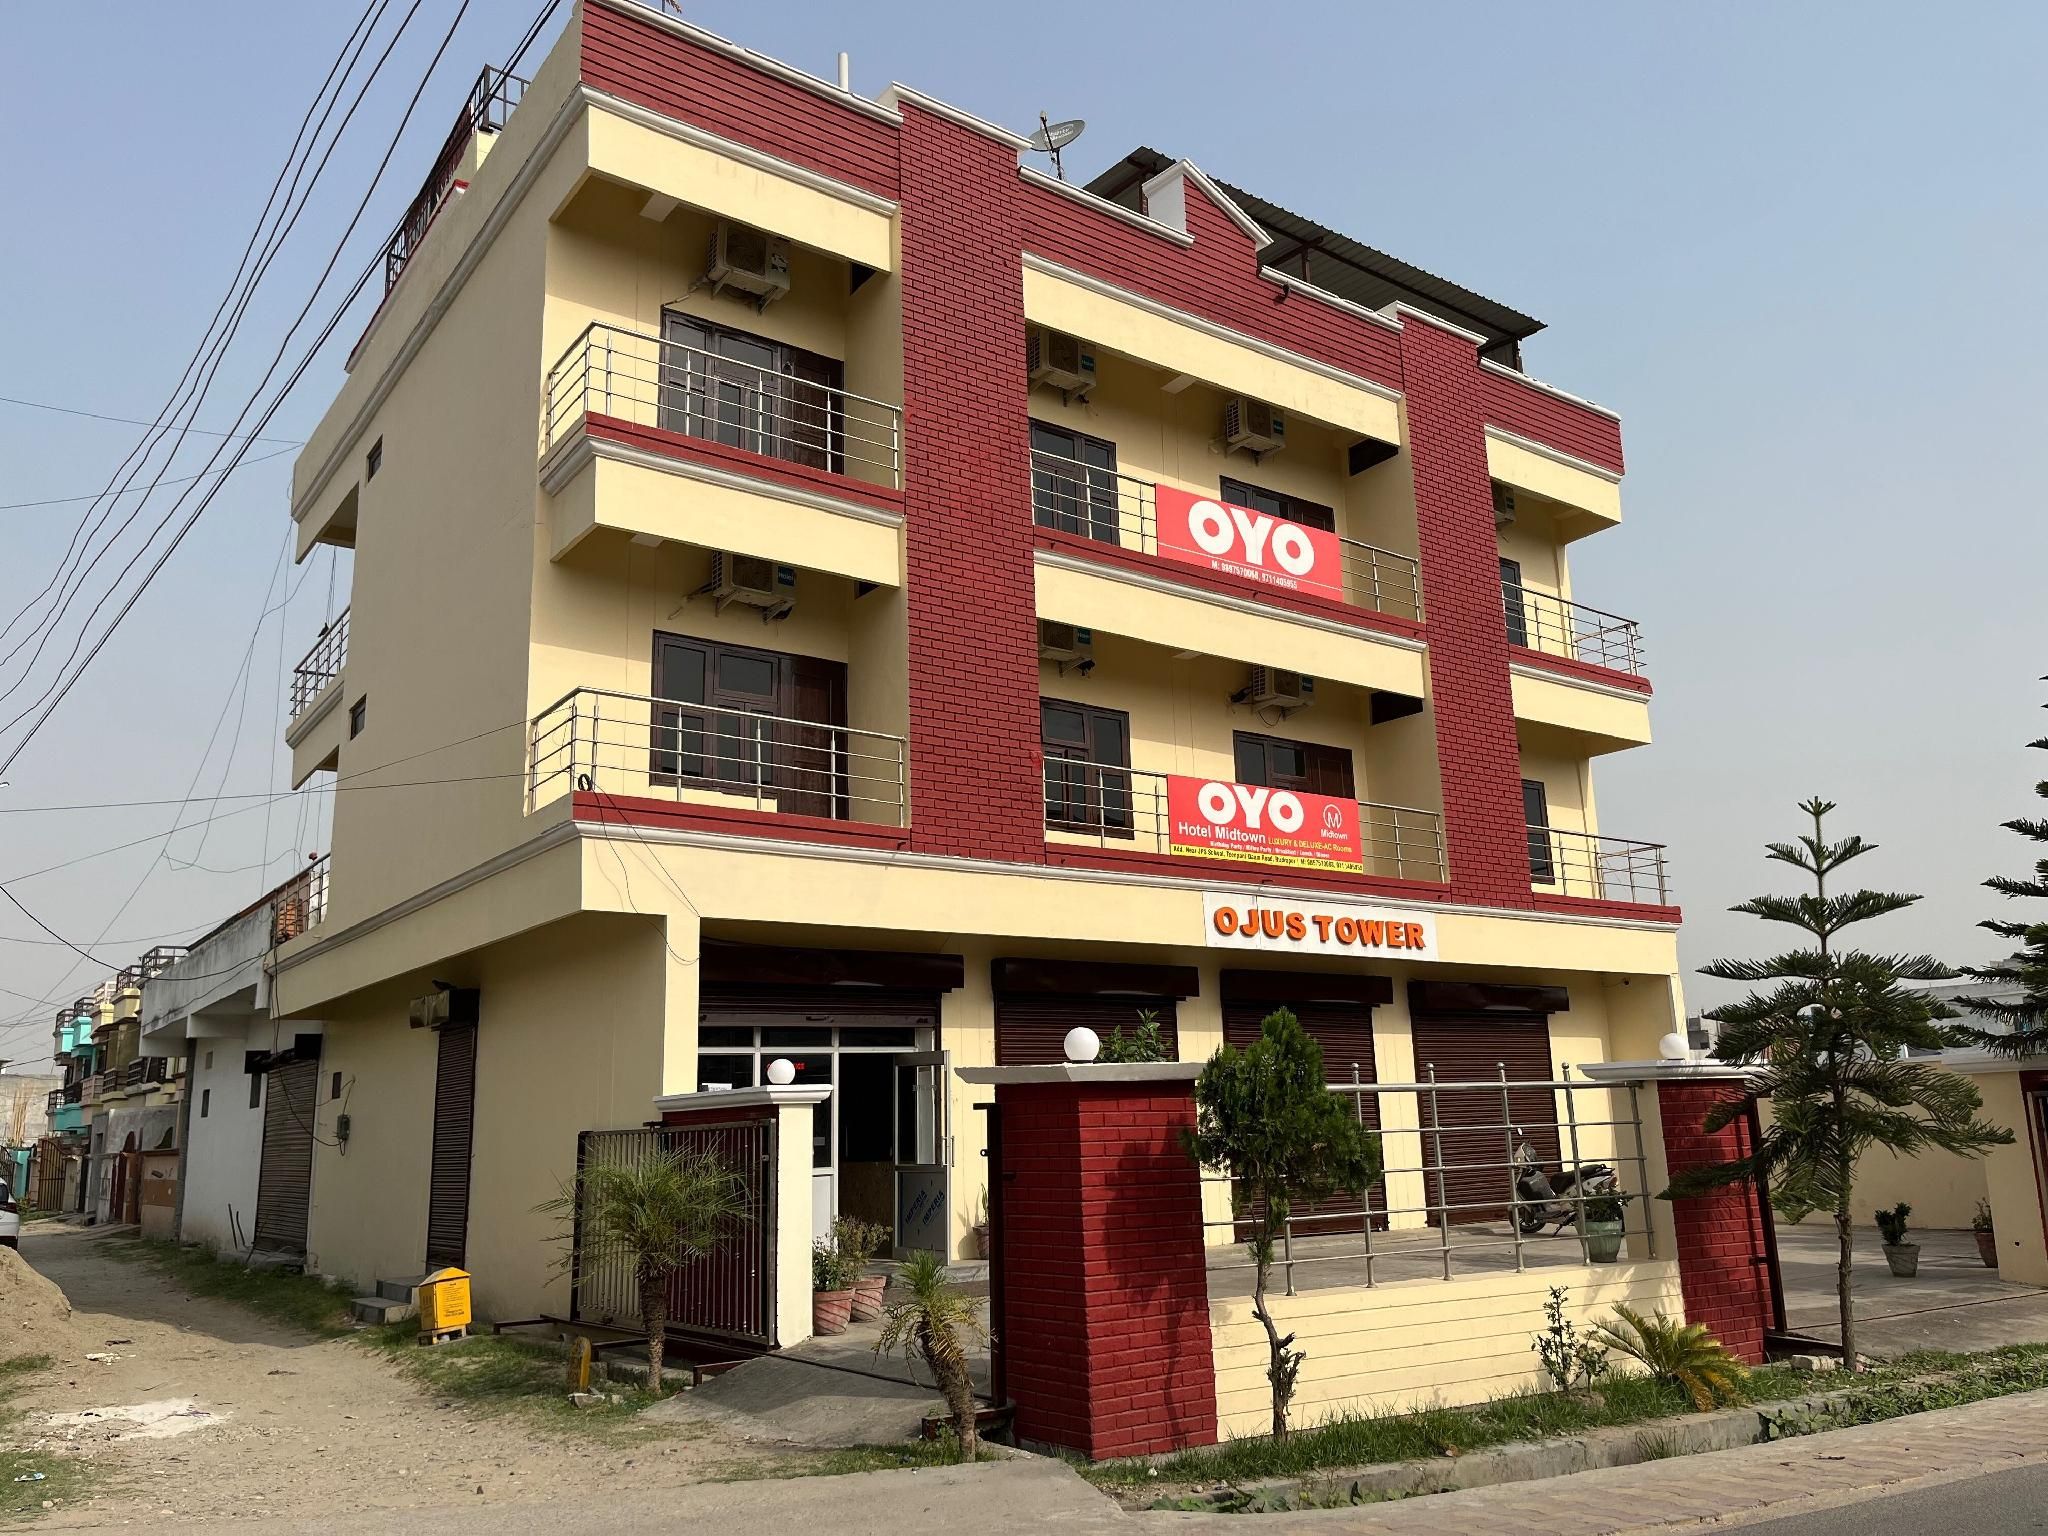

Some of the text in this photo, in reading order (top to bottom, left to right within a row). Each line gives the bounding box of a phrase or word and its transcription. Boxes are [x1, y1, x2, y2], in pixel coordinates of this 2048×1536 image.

[1188, 500, 1315, 576] OYO
[1211, 560, 1220, 571] M:
[1198, 782, 1304, 833] OYO
[1178, 822, 1211, 838] Hotel
[1215, 825, 1265, 844] Midtown
[1268, 837, 1292, 847] LUXURY
[1293, 839, 1298, 848] &
[1333, 844, 1352, 853] Rooms
[1320, 828, 1347, 840] Midtown
[1214, 906, 1426, 948] OJUS TOWER
